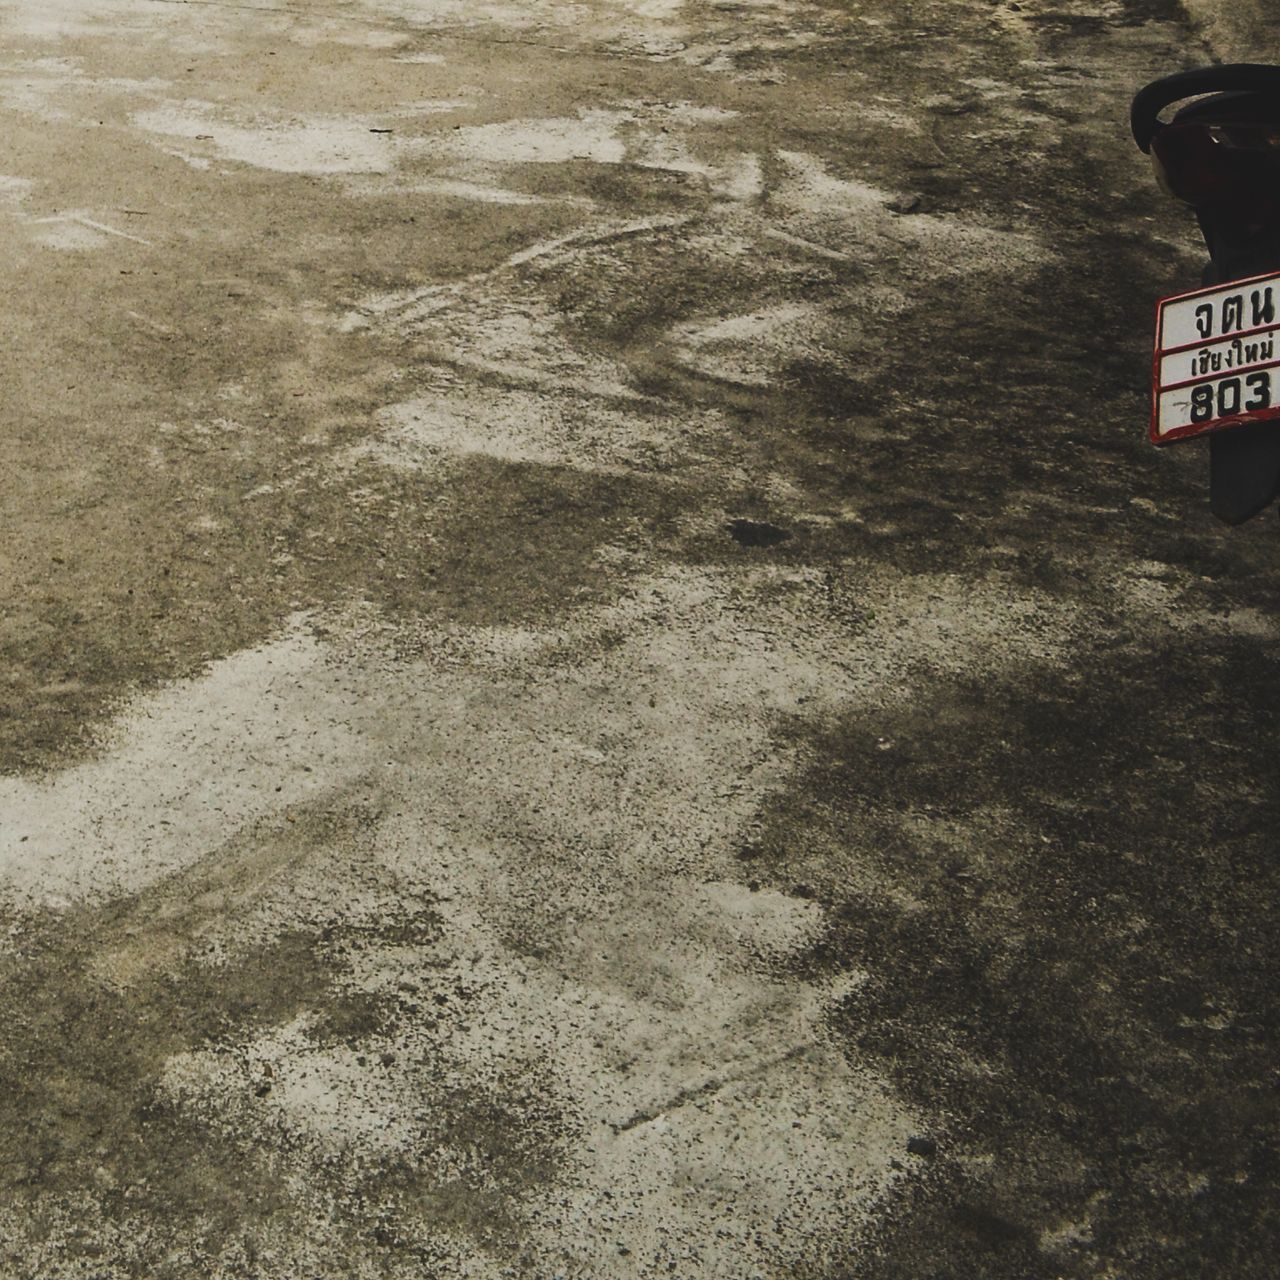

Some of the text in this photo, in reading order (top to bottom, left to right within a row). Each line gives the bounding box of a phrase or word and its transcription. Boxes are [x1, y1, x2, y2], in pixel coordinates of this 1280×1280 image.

[1195, 287, 1275, 339] จตน
[1192, 332, 1273, 376] เชียงใหม่
[1191, 371, 1271, 424] 803
